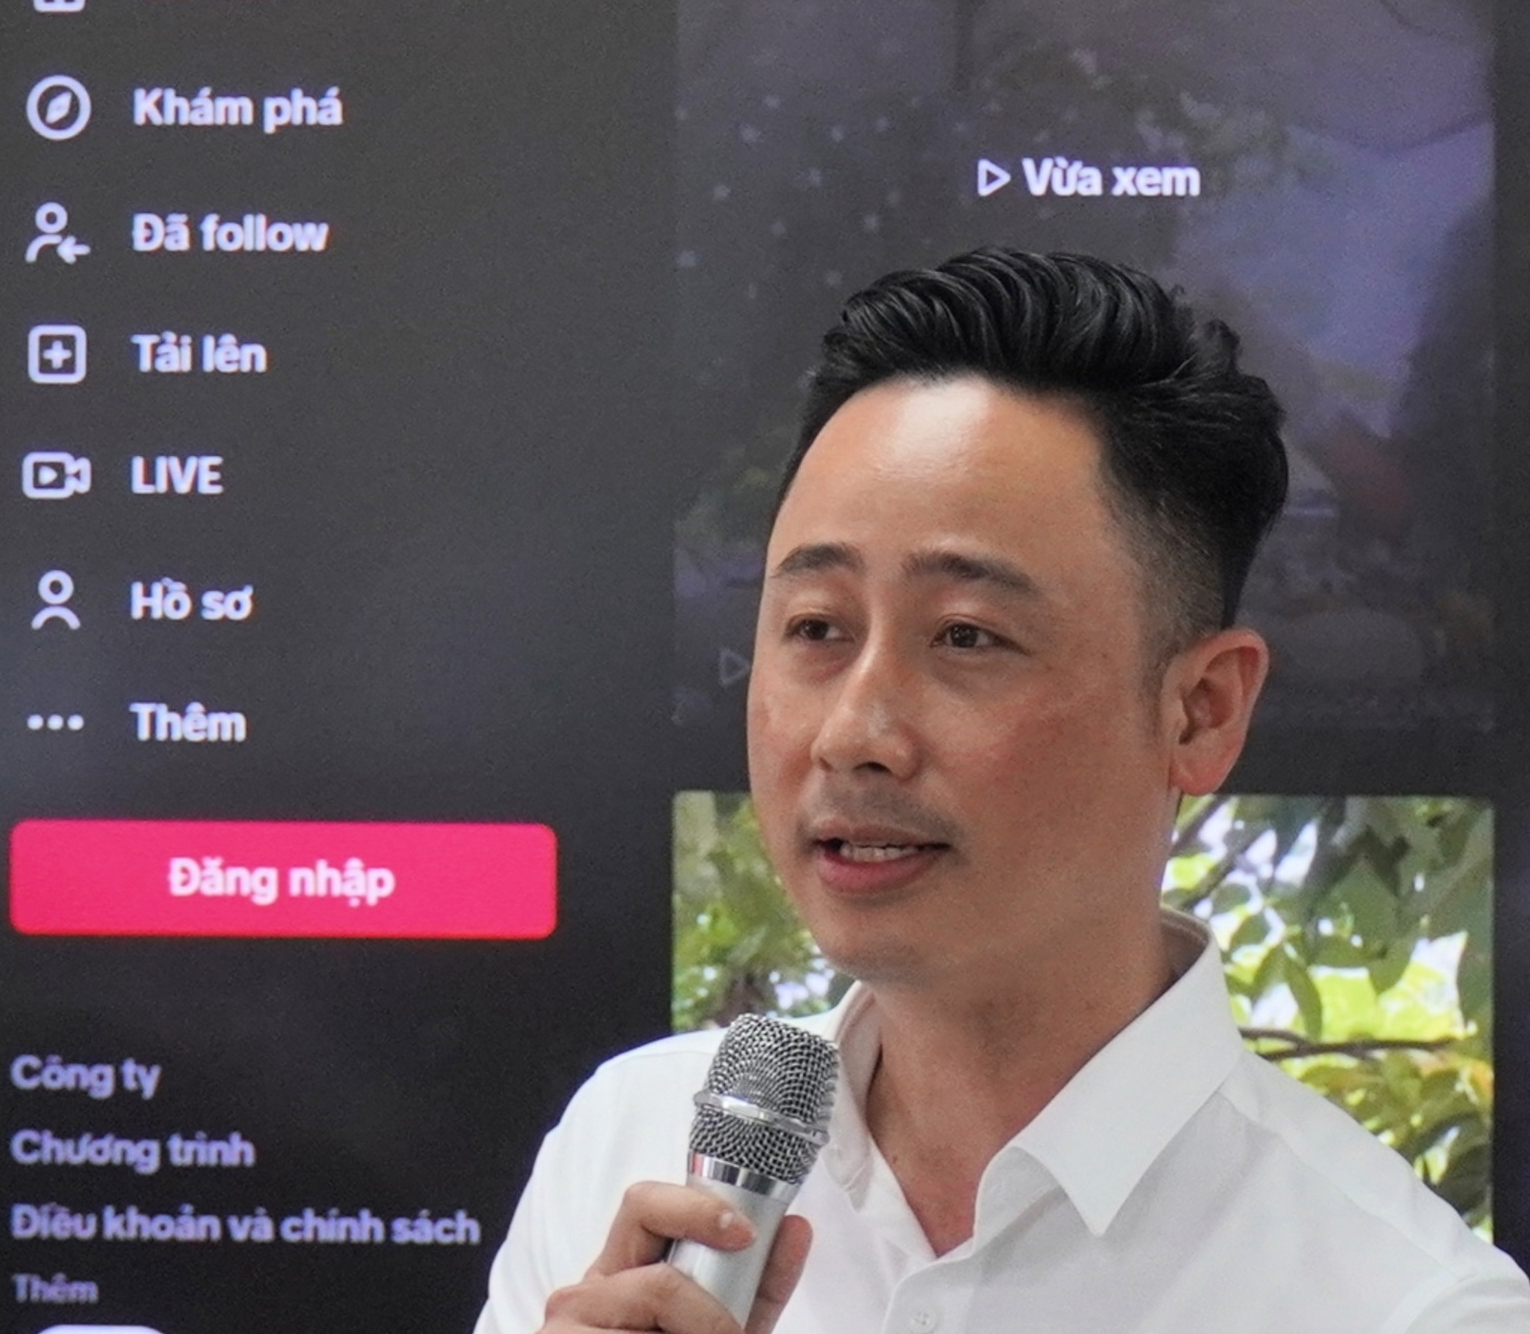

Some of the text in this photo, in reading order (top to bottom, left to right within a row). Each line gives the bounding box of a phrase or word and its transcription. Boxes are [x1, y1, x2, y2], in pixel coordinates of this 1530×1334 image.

[132, 85, 344, 134] Khám phá
[1021, 156, 1201, 197] Vừa xem
[131, 213, 330, 252] Đã follow
[131, 332, 268, 373] Tải lên
[131, 455, 224, 495] LIVE
[131, 577, 254, 620] Hồ sơ
[130, 702, 247, 743] Thêm
[169, 857, 396, 908] Đăng nhập
[10, 1054, 162, 1100] Công ty
[10, 1128, 256, 1175] Chương trình
[10, 1201, 481, 1245] Điều khoản và chính sách
[13, 1272, 99, 1305] Thêm
